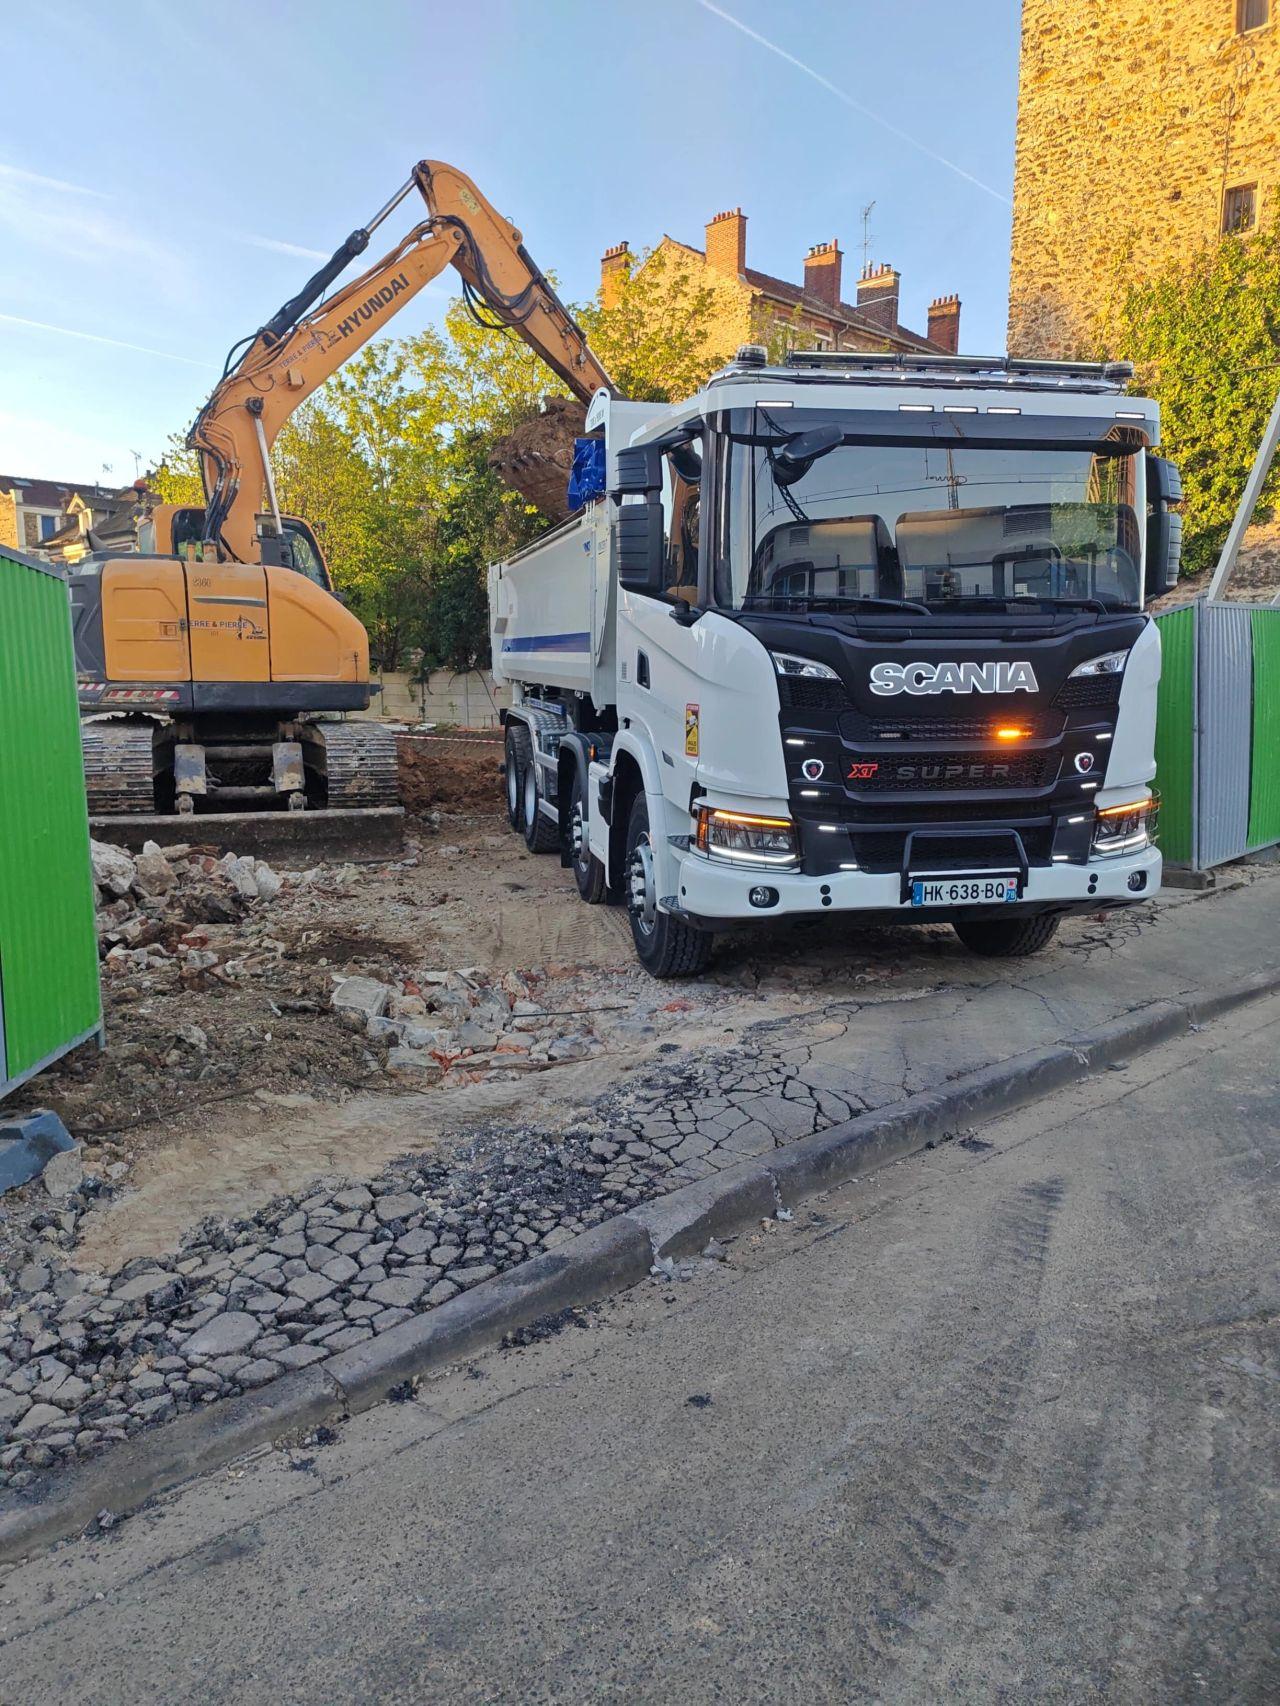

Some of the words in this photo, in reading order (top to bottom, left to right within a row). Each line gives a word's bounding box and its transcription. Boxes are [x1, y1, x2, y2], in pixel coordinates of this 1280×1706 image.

[337, 273, 410, 338] HYUNDAI
[219, 620, 248, 629] PIERRE
[869, 662, 1039, 696] SCANIA
[847, 763, 879, 779] XT
[897, 764, 1009, 780] SUPER
[924, 882, 1005, 901] HK-638-BQ
